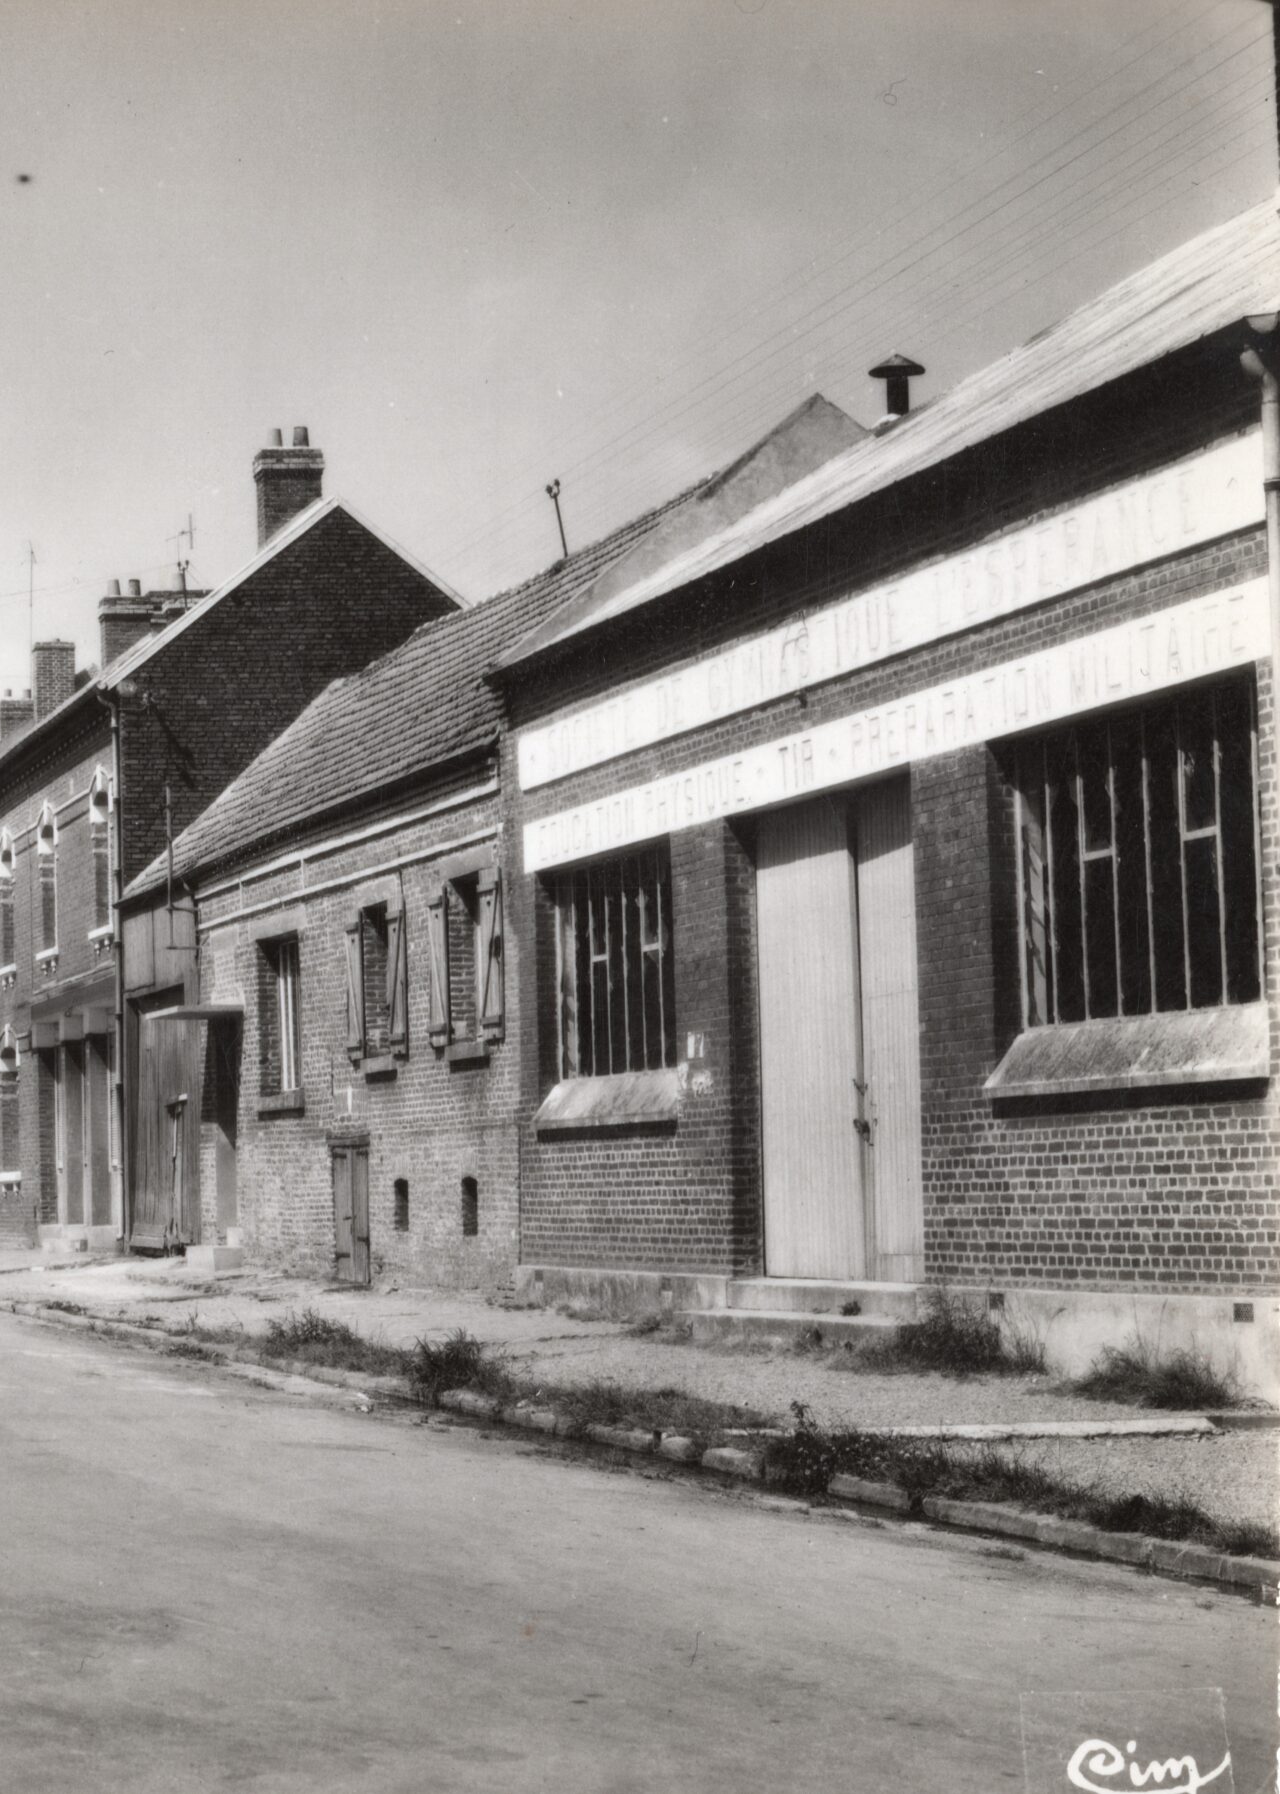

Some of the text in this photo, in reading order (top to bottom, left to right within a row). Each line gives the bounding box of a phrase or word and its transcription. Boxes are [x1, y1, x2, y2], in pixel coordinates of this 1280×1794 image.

[539, 595, 1247, 863] EDUCATION PHYSIQUE TIR PREPARATION MILITAIRE
[656, 677, 685, 733] DE
[707, 589, 903, 712] GYMNASTIQUE
